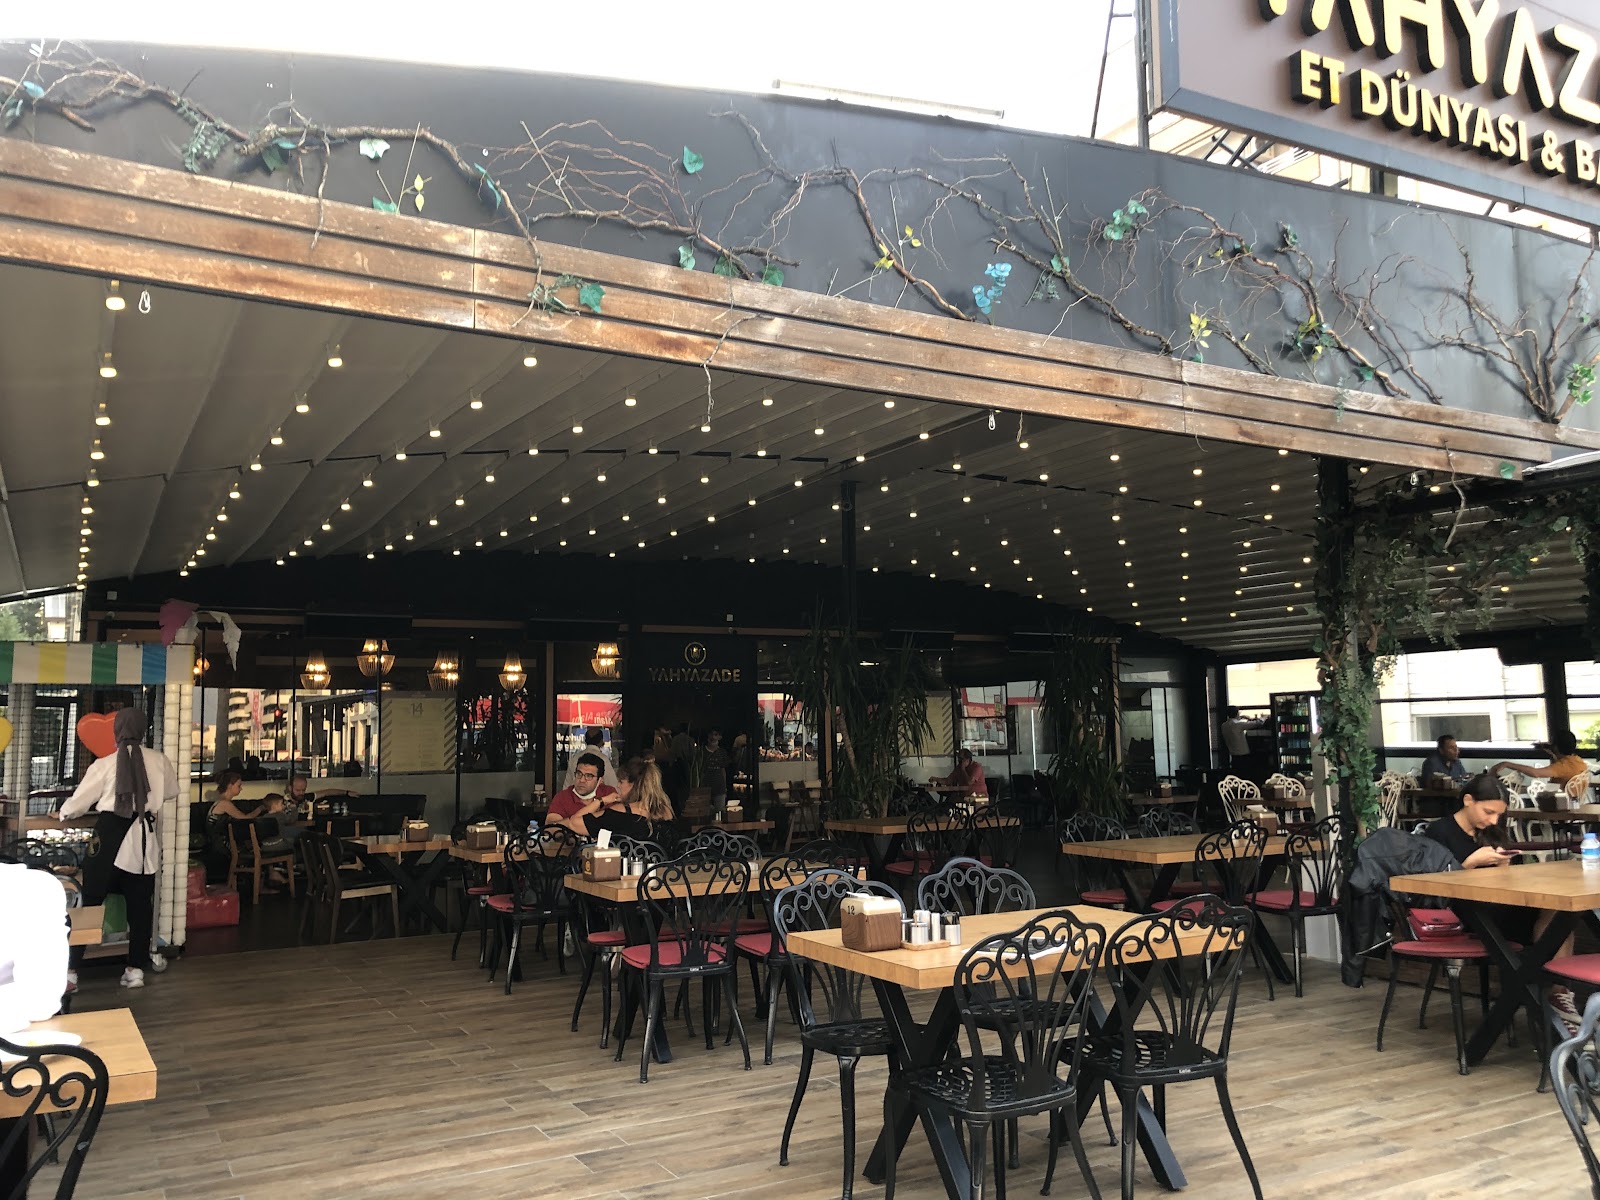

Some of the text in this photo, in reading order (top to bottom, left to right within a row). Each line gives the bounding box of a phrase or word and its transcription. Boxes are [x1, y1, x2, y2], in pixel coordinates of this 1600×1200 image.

[1268, 0, 1600, 124] HYAZ
[1300, 49, 1600, 185] ET DÜNYASI & B
[648, 667, 741, 682] YAHYAZADE
[847, 904, 855, 916] 12
